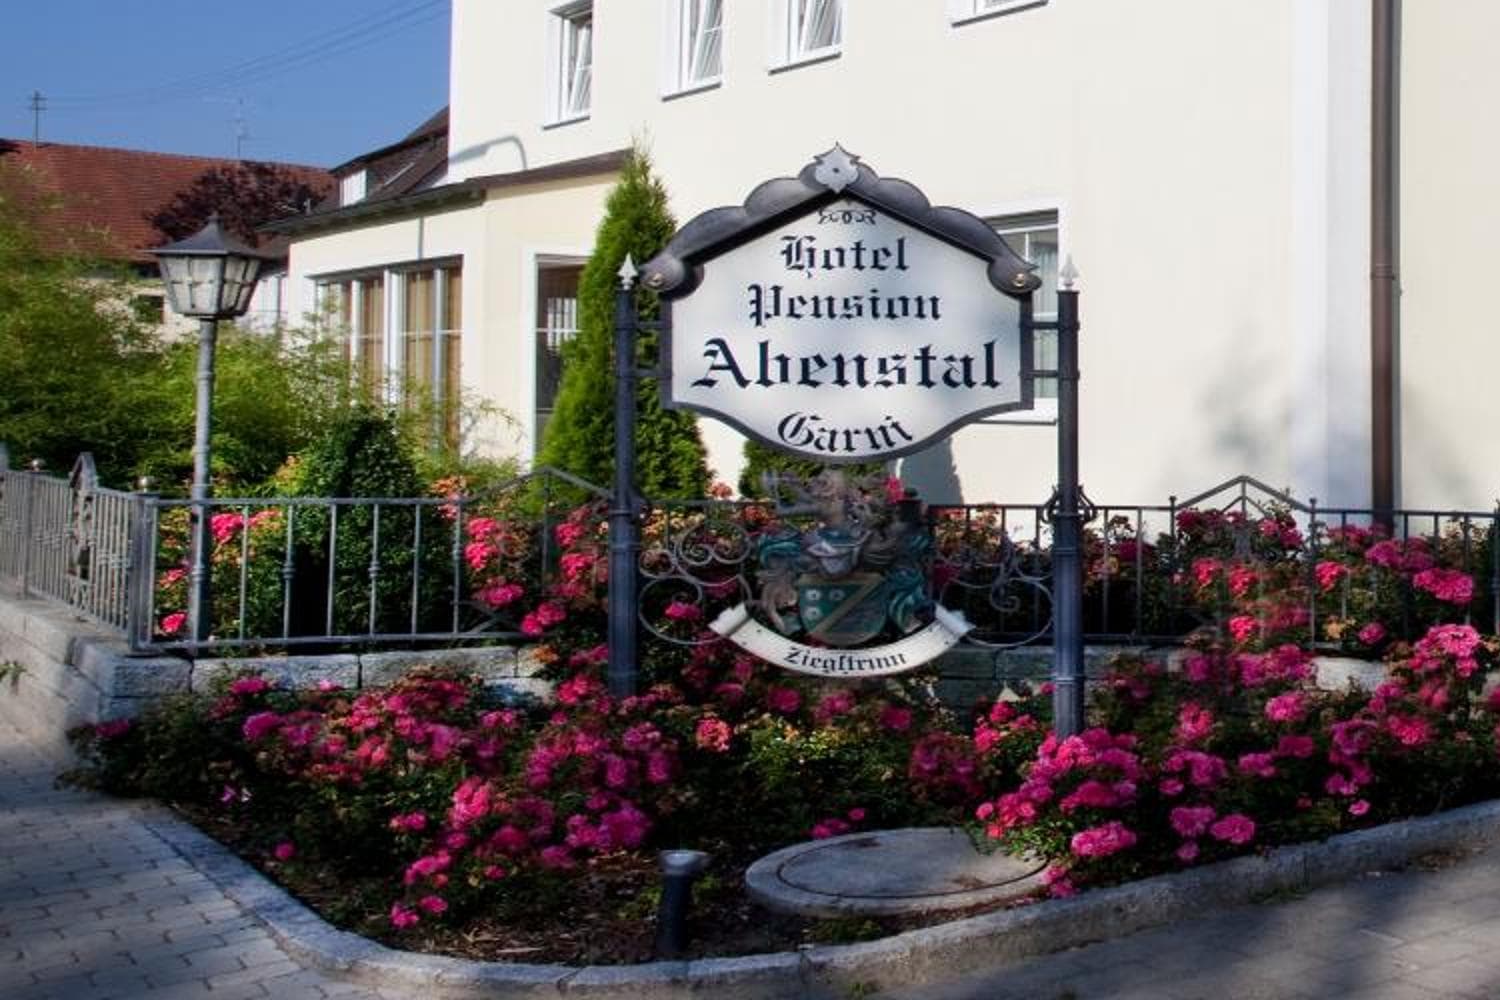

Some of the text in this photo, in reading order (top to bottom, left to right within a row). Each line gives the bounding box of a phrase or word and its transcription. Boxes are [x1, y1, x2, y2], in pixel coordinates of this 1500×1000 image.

[780, 234, 910, 278] Hotel
[747, 283, 942, 327] Pension
[691, 337, 1001, 389] Abenstal
[777, 411, 913, 452] Garni
